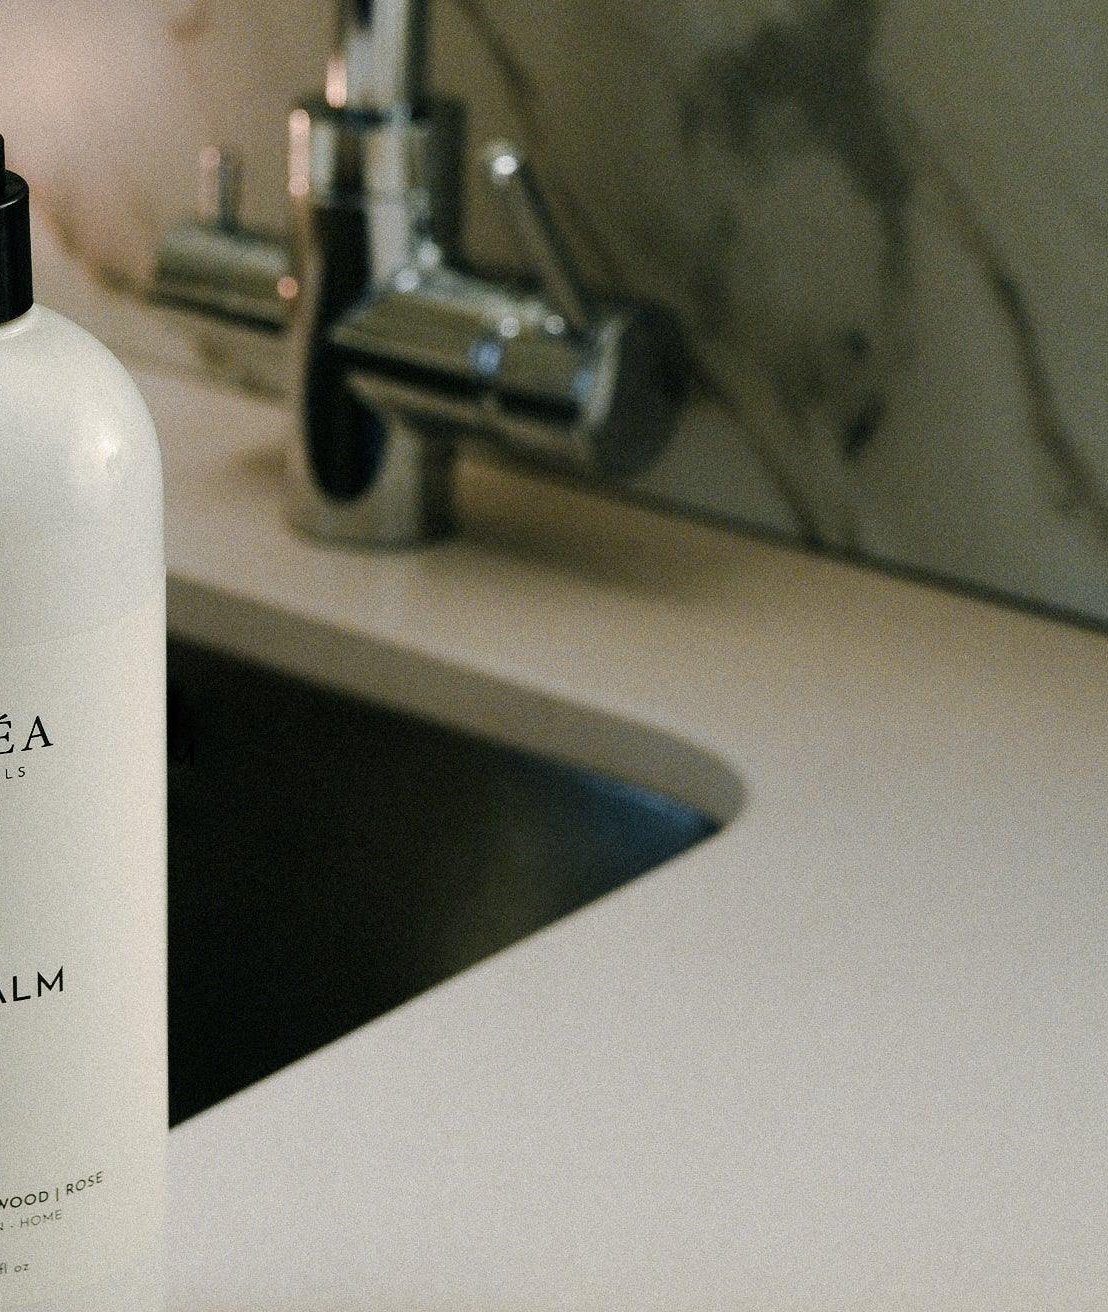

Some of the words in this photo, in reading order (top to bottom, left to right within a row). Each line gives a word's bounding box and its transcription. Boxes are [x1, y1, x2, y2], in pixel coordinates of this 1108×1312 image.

[66, 1171, 103, 1195] ROSE
[20, 1208, 63, 1229] HOME
[0, 1262, 7, 1275] fl
[14, 1263, 29, 1273] oz
